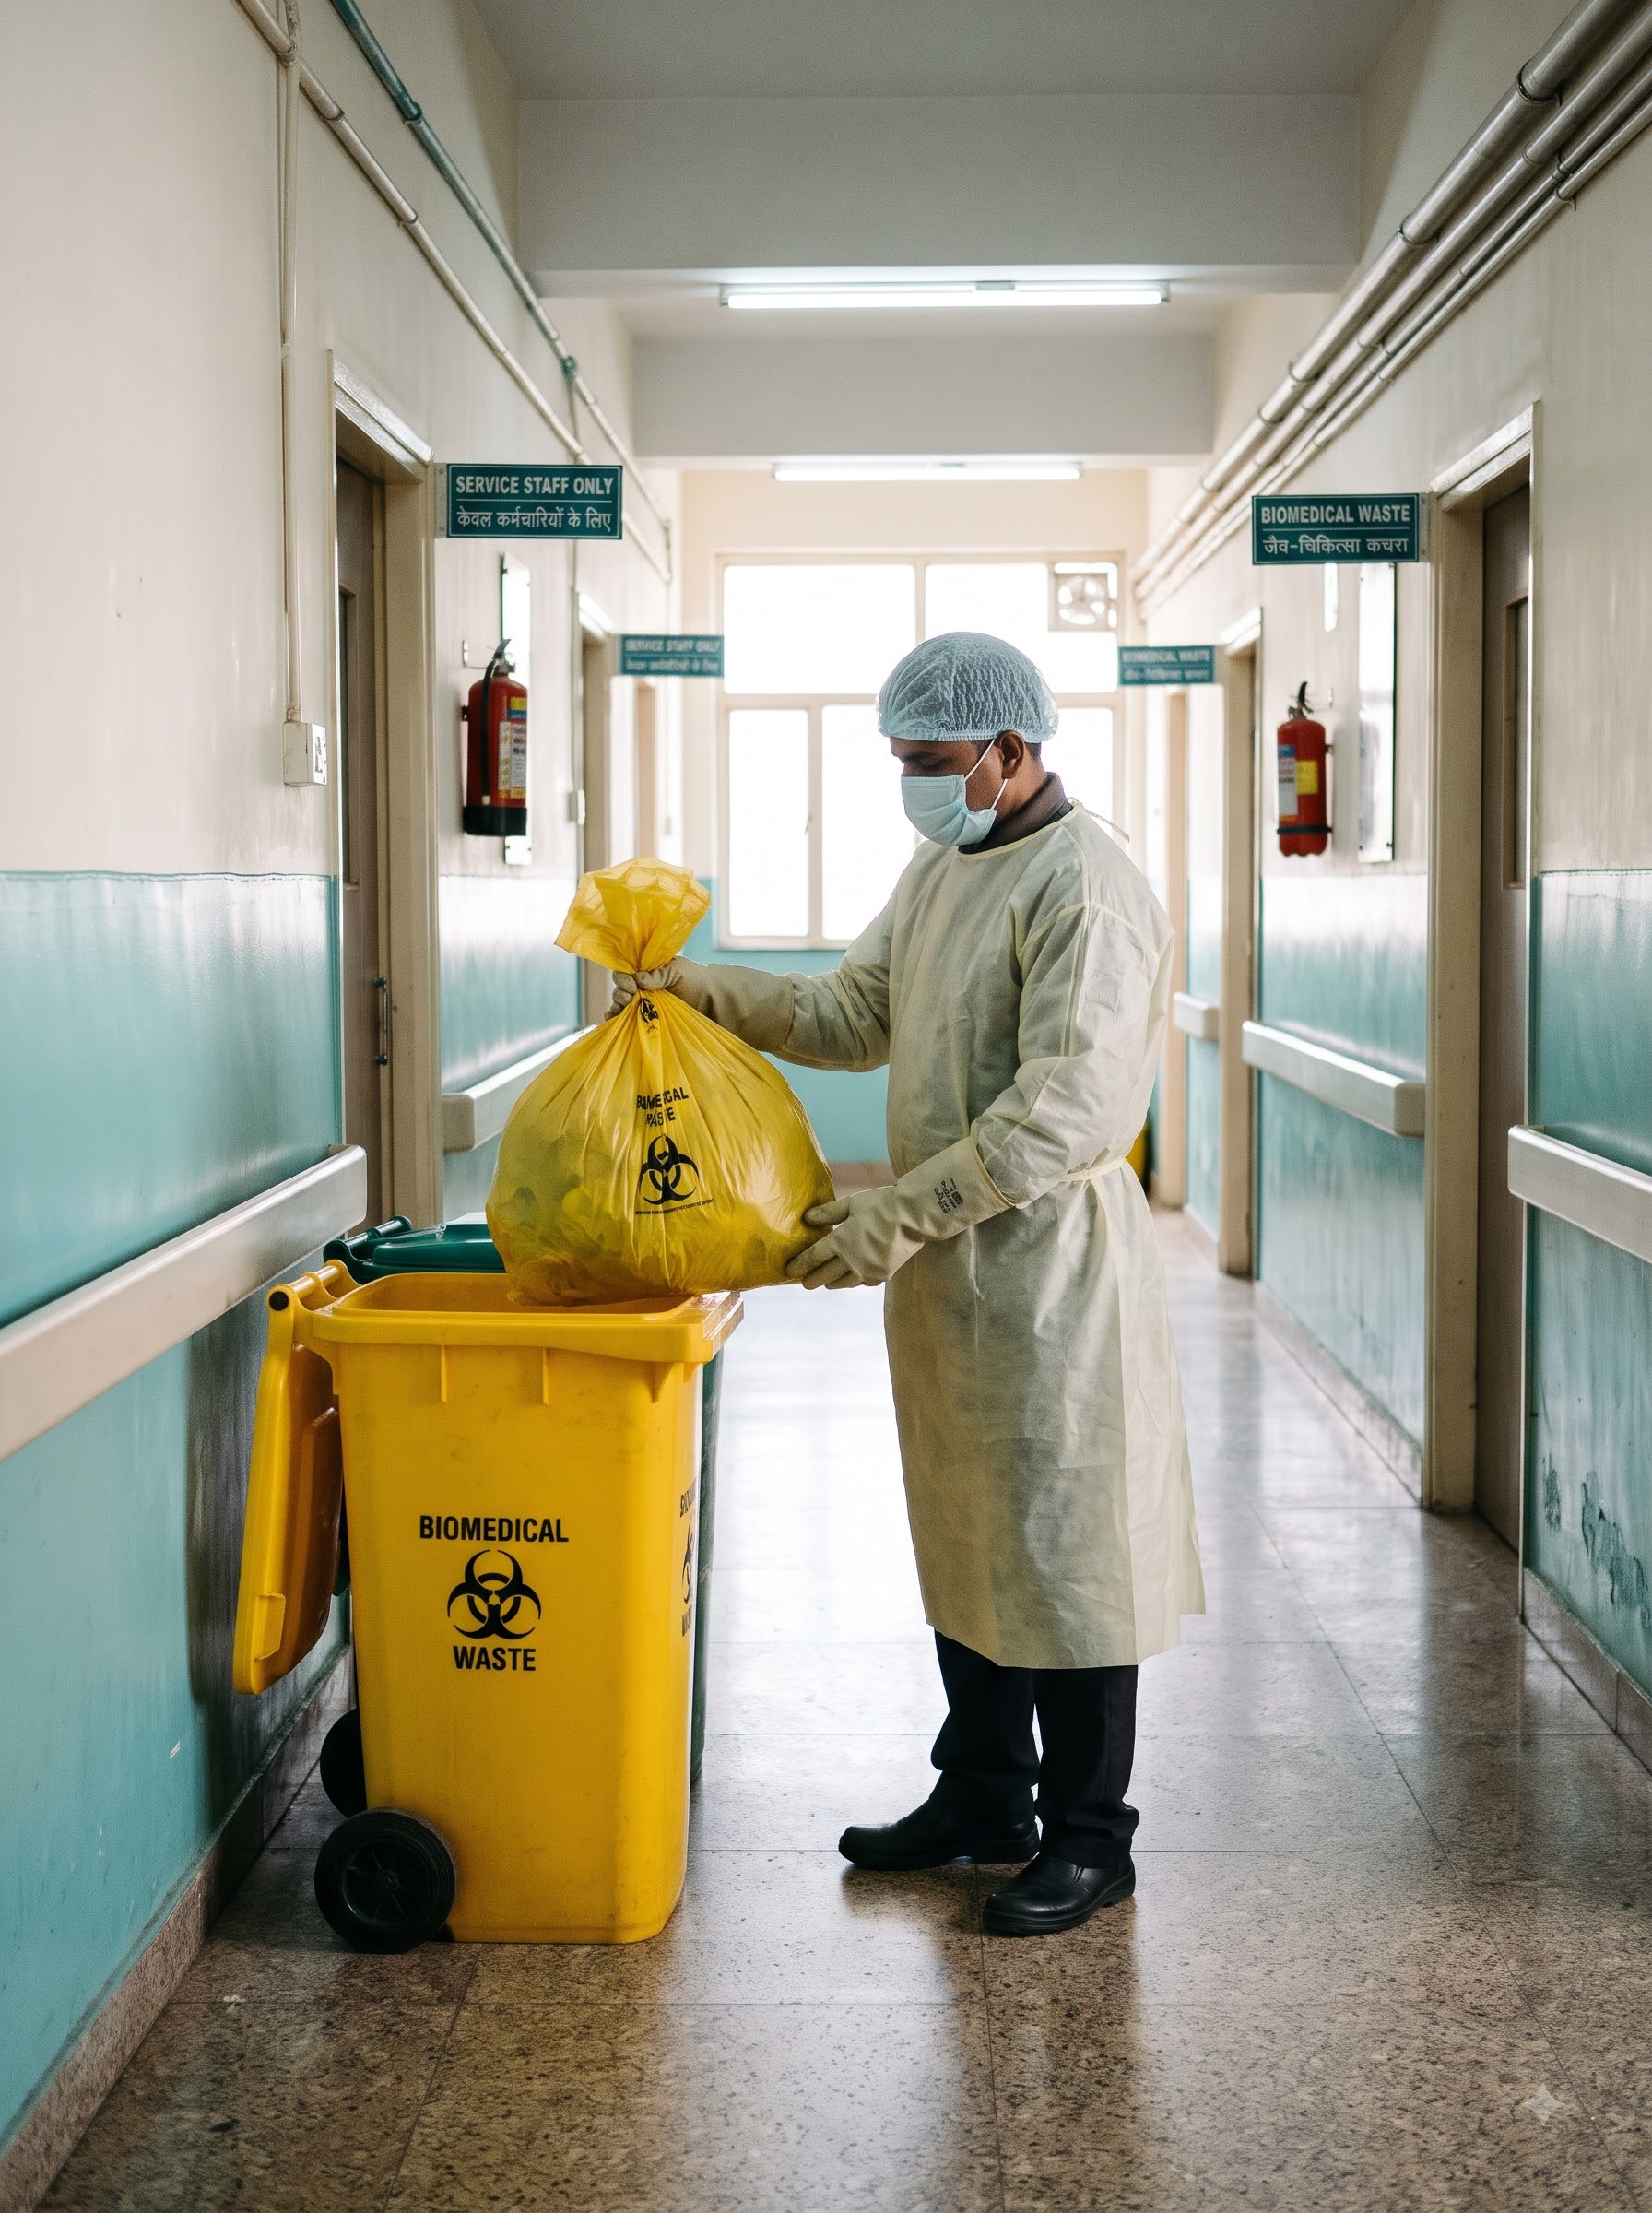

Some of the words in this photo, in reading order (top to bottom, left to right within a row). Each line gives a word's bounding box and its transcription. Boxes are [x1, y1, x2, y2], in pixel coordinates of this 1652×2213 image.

[456, 476, 519, 494] SERVICE
[524, 476, 569, 494] STAFF
[573, 477, 614, 495] ONLY
[456, 505, 493, 527] केवल
[496, 506, 564, 528] कर्मचारियों
[567, 507, 582, 527] के
[585, 506, 612, 532] लिए
[1261, 505, 1354, 524] BIOMEDICAL
[1358, 504, 1410, 523] WASTE
[1263, 534, 1361, 555] जैव-चिकित्सा
[1366, 538, 1409, 553] कचरा
[419, 1515, 569, 1543] BIOMEDICAL
[453, 1645, 537, 1671] WASTE
